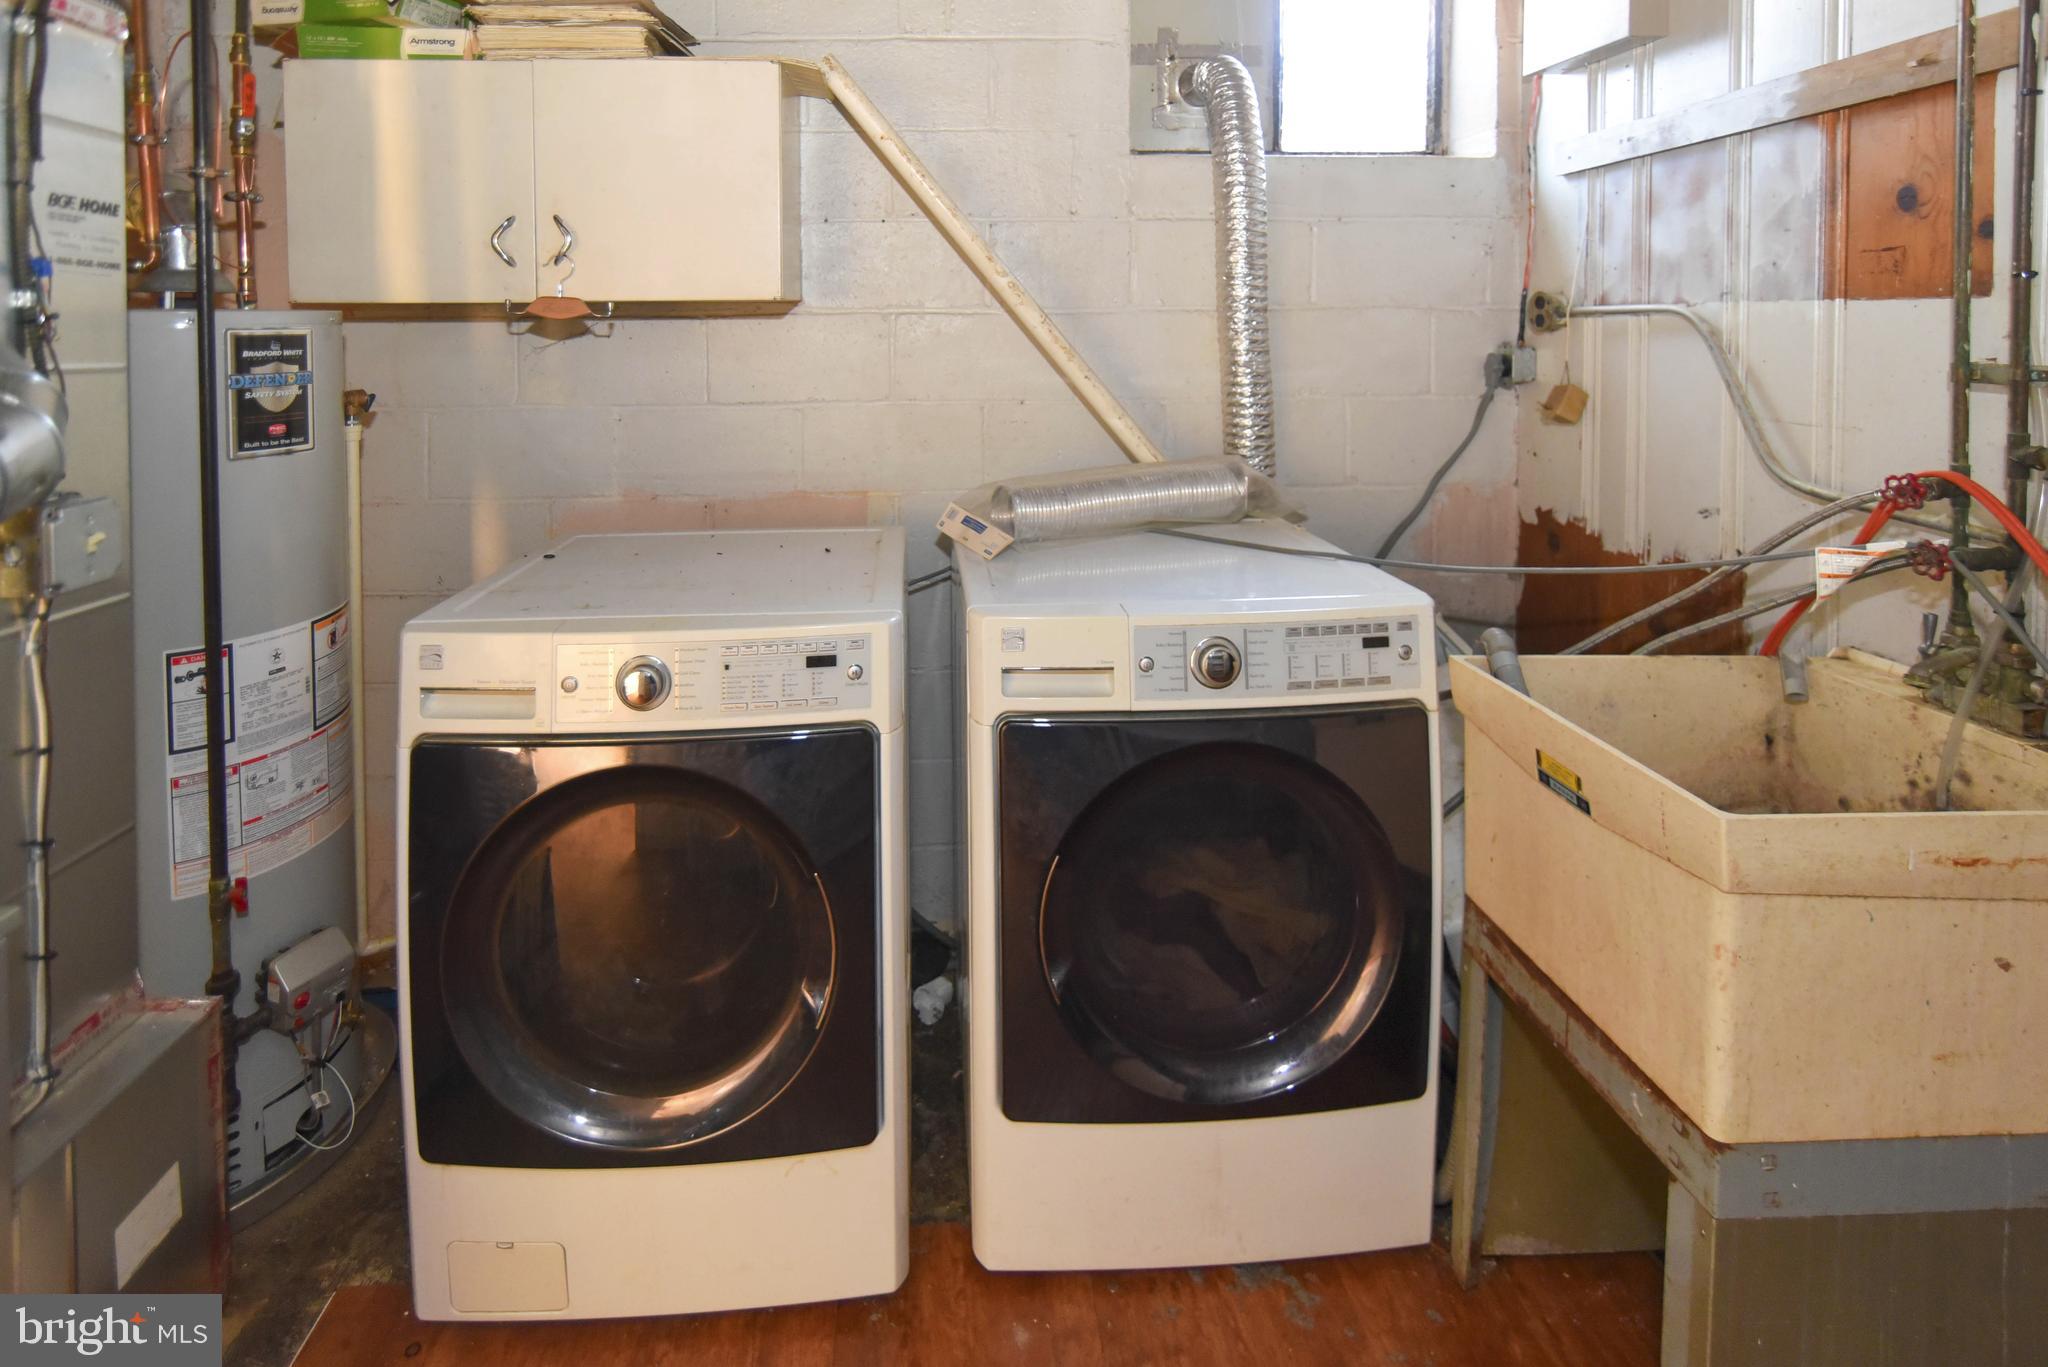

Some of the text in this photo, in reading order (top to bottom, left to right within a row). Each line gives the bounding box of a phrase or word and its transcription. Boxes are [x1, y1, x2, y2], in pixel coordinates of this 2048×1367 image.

[410, 37, 456, 48] Armstrong
[47, 192, 120, 218] BGE HOME
[243, 348, 303, 358] BRADFORD WHITE
[230, 372, 312, 389] DEFENDER
[245, 390, 274, 399] SAFETY
[245, 441, 260, 449] Built
